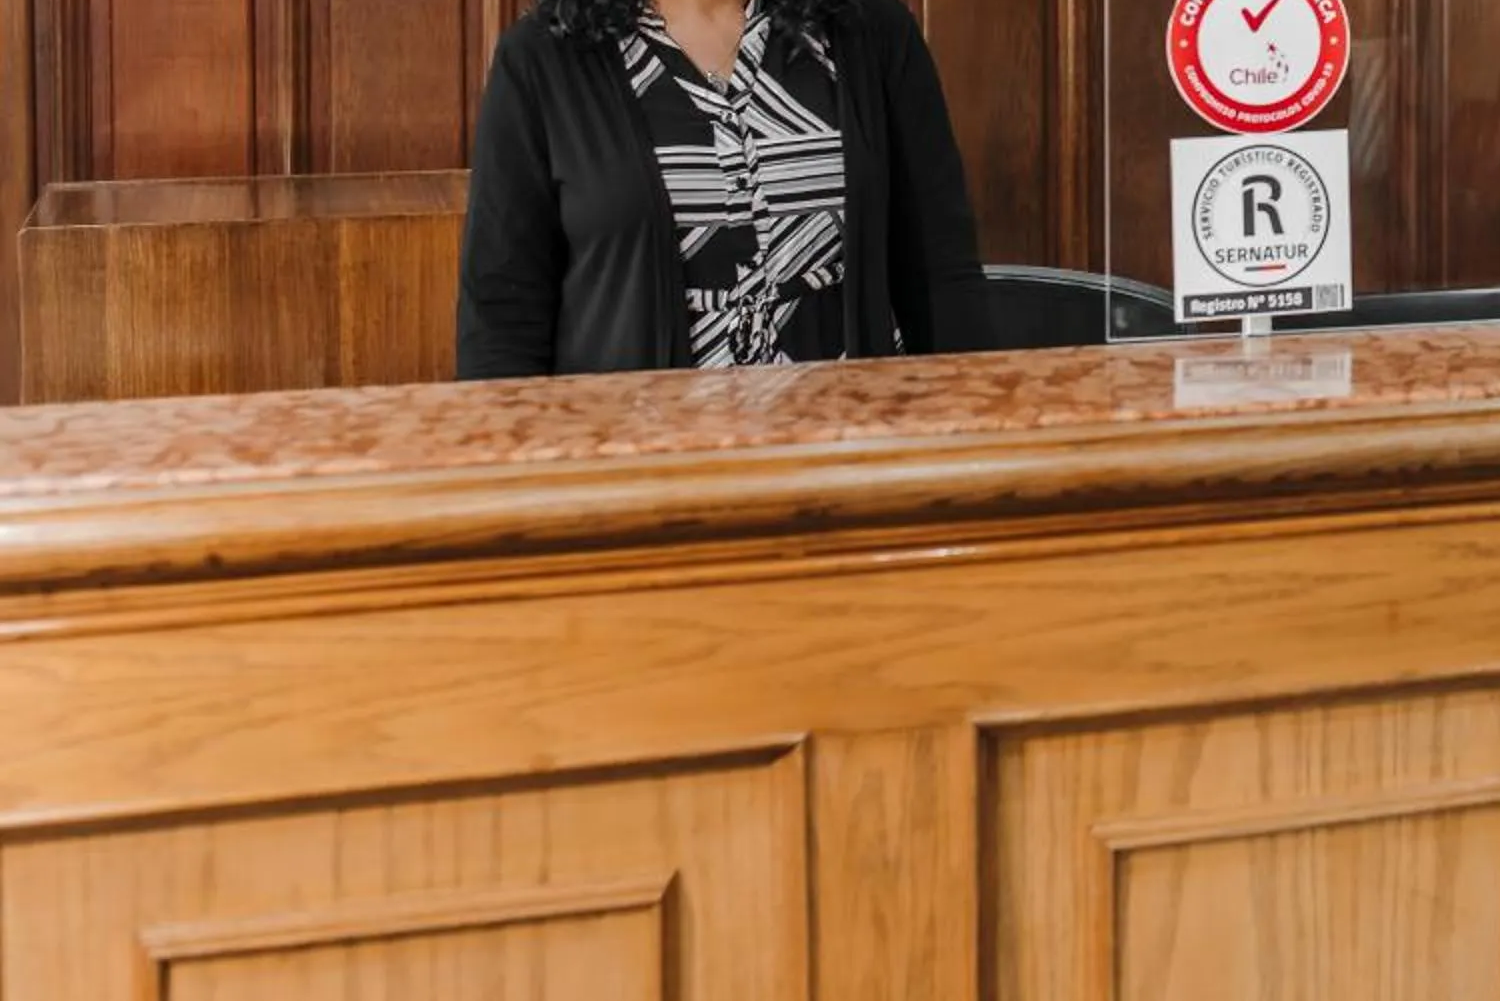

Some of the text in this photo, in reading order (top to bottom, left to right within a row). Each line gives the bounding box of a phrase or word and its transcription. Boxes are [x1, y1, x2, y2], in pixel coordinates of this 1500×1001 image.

[1229, 67, 1279, 86] Chile
[1200, 149, 1324, 242] SERVICIO TURÍSTICO REGISTRADO
[1241, 174, 1285, 238] R
[1214, 242, 1310, 265] SERNATUR
[1190, 297, 1246, 316] Registro
